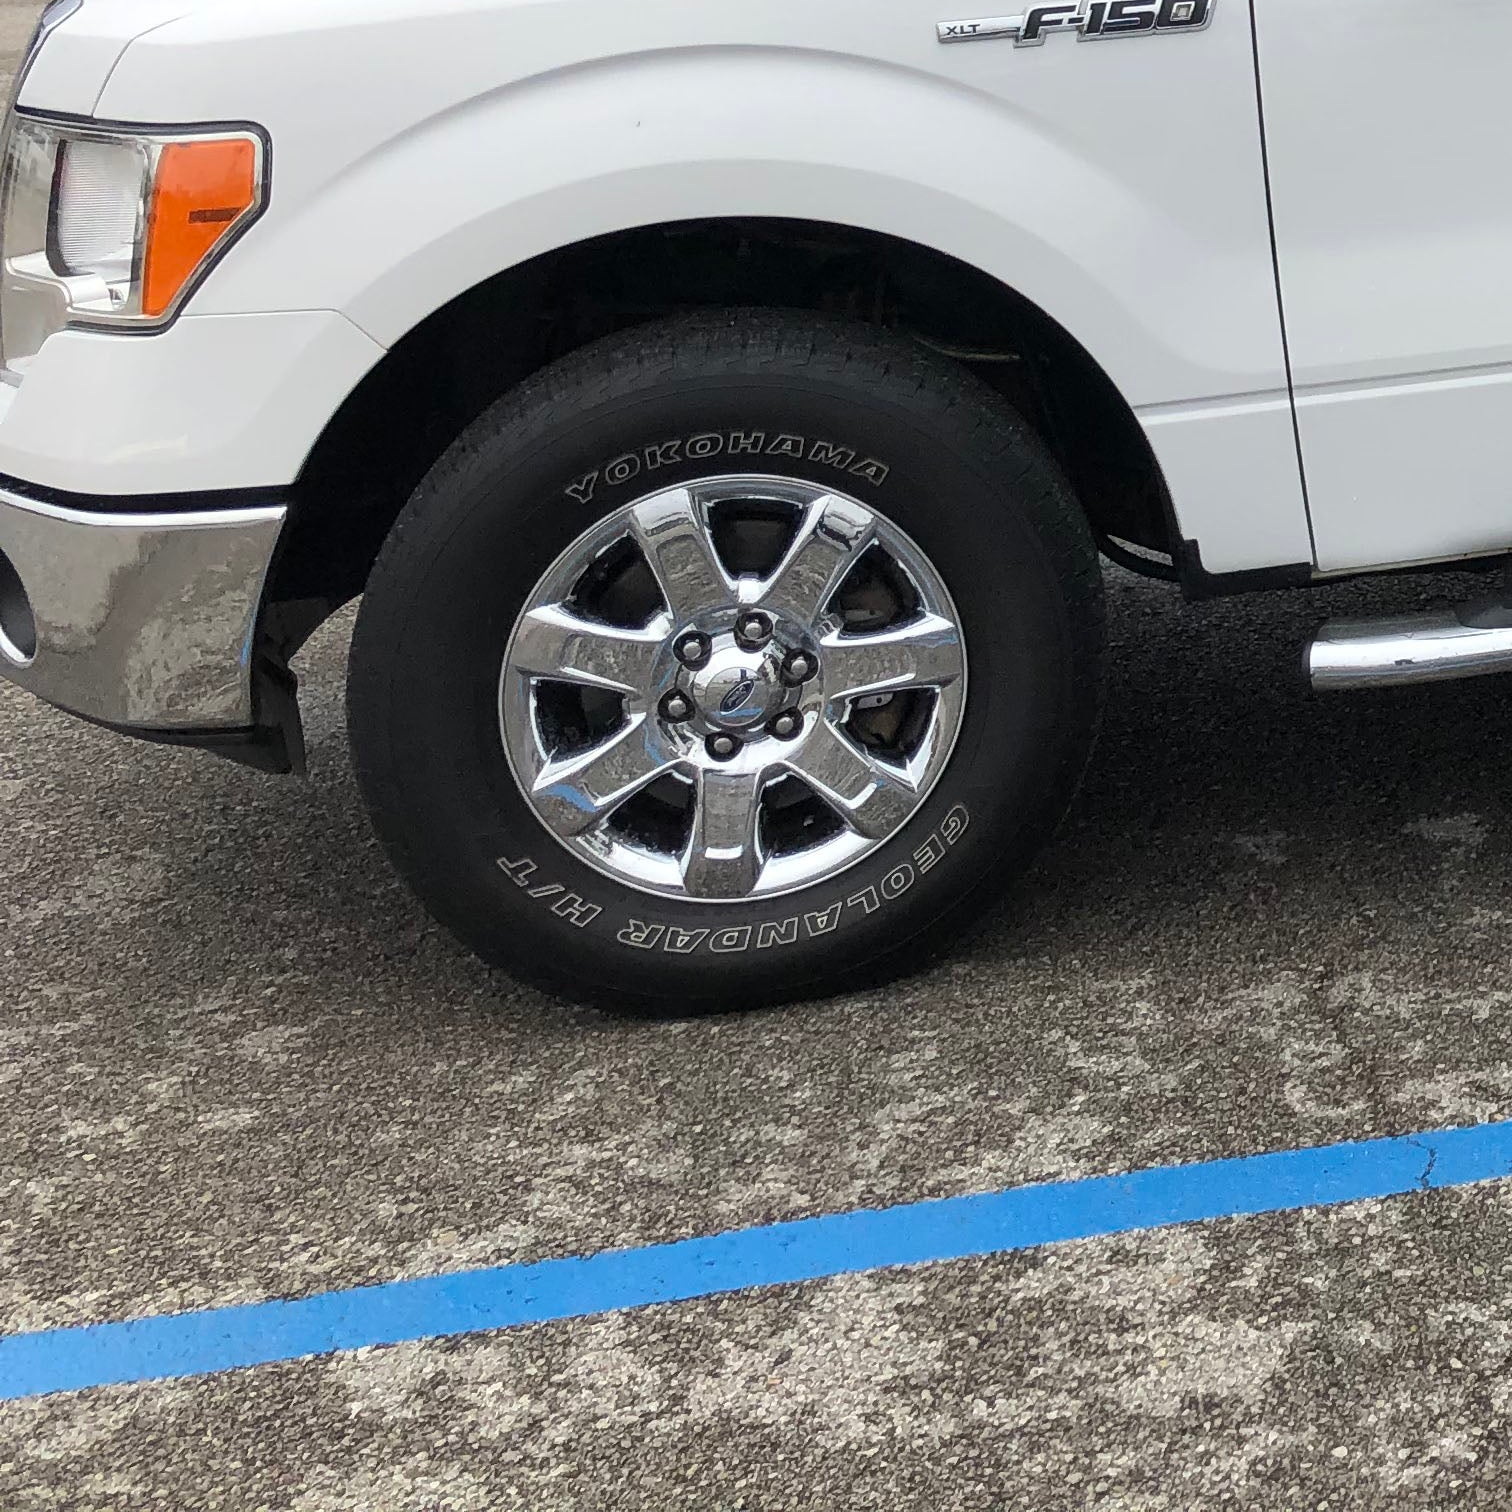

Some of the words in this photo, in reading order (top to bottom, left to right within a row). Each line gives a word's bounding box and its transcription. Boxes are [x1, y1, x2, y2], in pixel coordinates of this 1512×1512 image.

[945, 23, 981, 36] XLT
[565, 431, 889, 503] YOKOHAMA
[496, 854, 602, 928] H/T
[617, 802, 970, 954] GEOLANDAR
